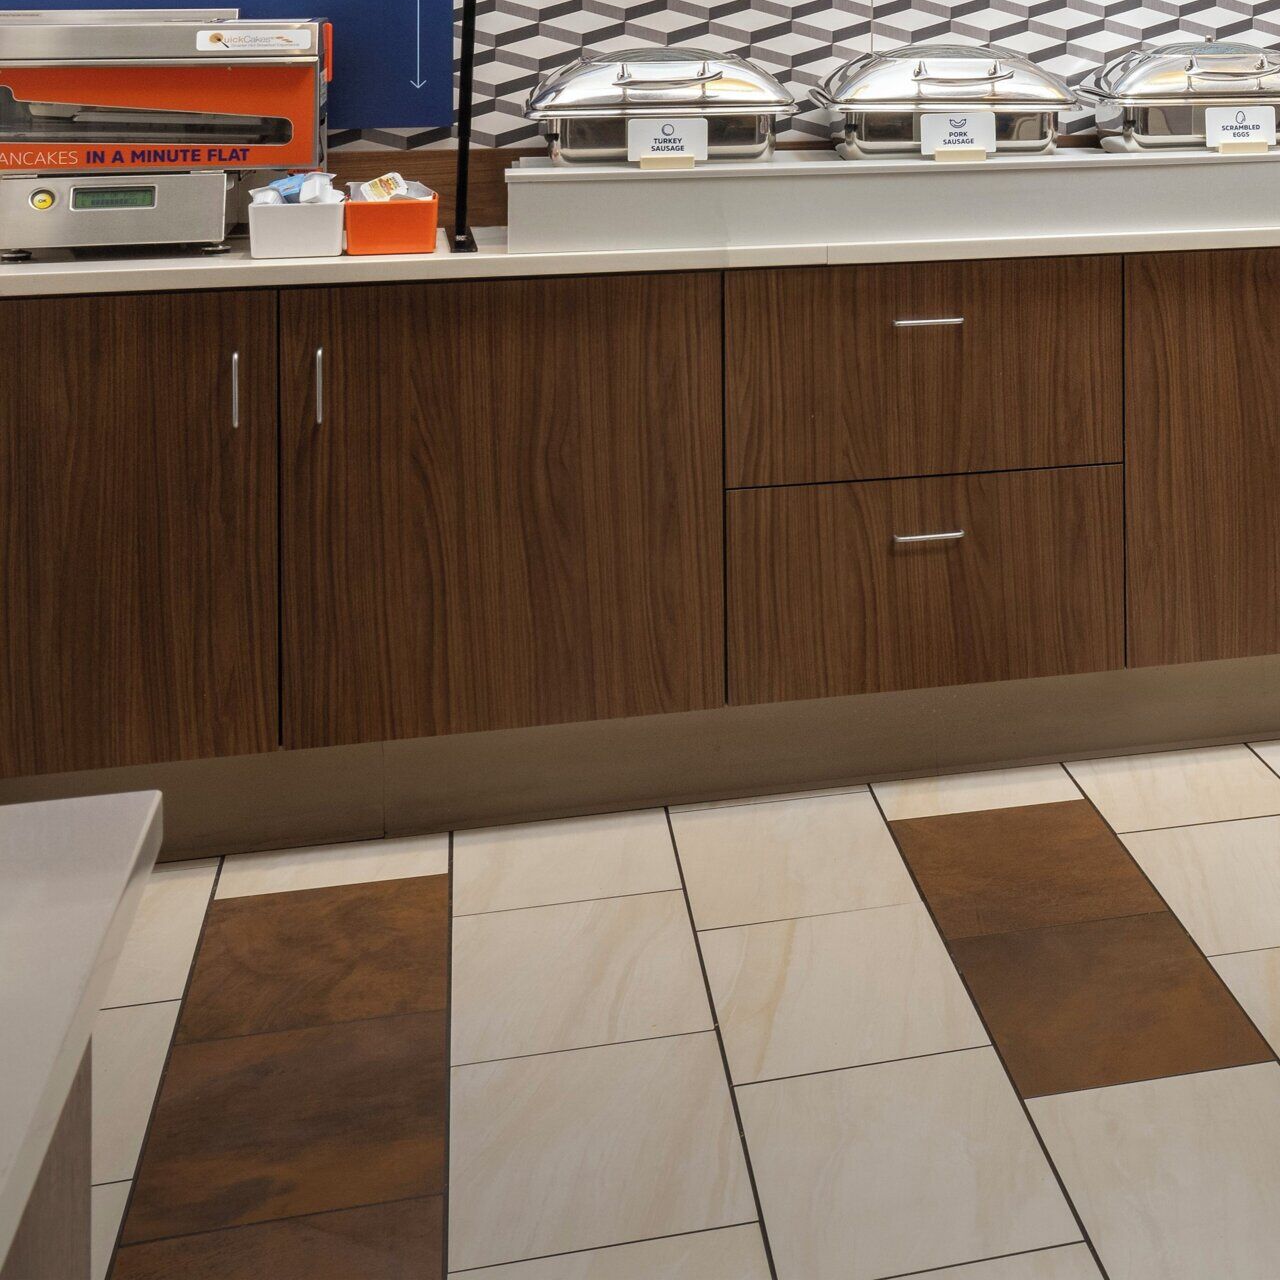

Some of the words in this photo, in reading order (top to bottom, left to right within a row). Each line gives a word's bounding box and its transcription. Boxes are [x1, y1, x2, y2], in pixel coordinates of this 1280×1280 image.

[942, 138, 975, 146] SAUSAGE
[0, 151, 79, 166] ANCAKES
[86, 150, 105, 164] IN
[111, 150, 125, 164] A
[131, 149, 200, 163] MINUTE
[207, 147, 250, 161] FLAT
